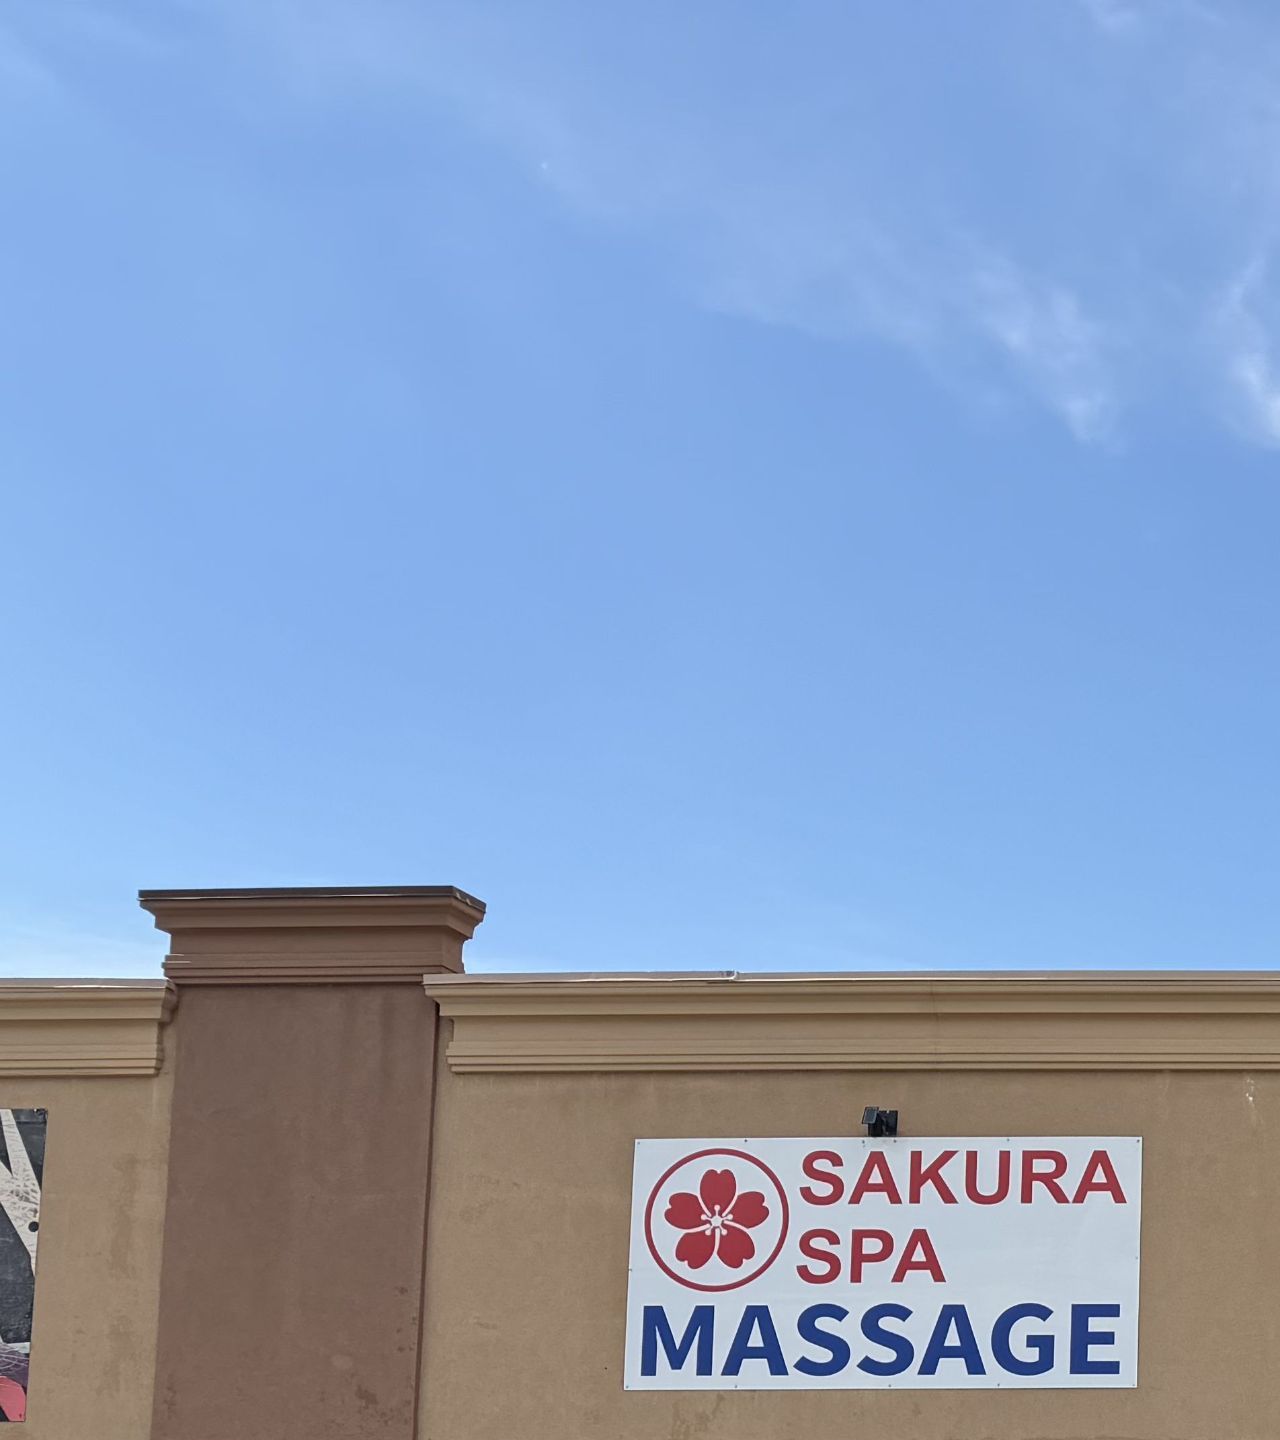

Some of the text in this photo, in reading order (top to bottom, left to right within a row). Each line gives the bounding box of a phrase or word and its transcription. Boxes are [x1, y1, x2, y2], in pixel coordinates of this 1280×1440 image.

[798, 1149, 1127, 1206] SAKURA
[796, 1228, 946, 1284] SPA
[640, 1302, 1121, 1377] MASSAGE
